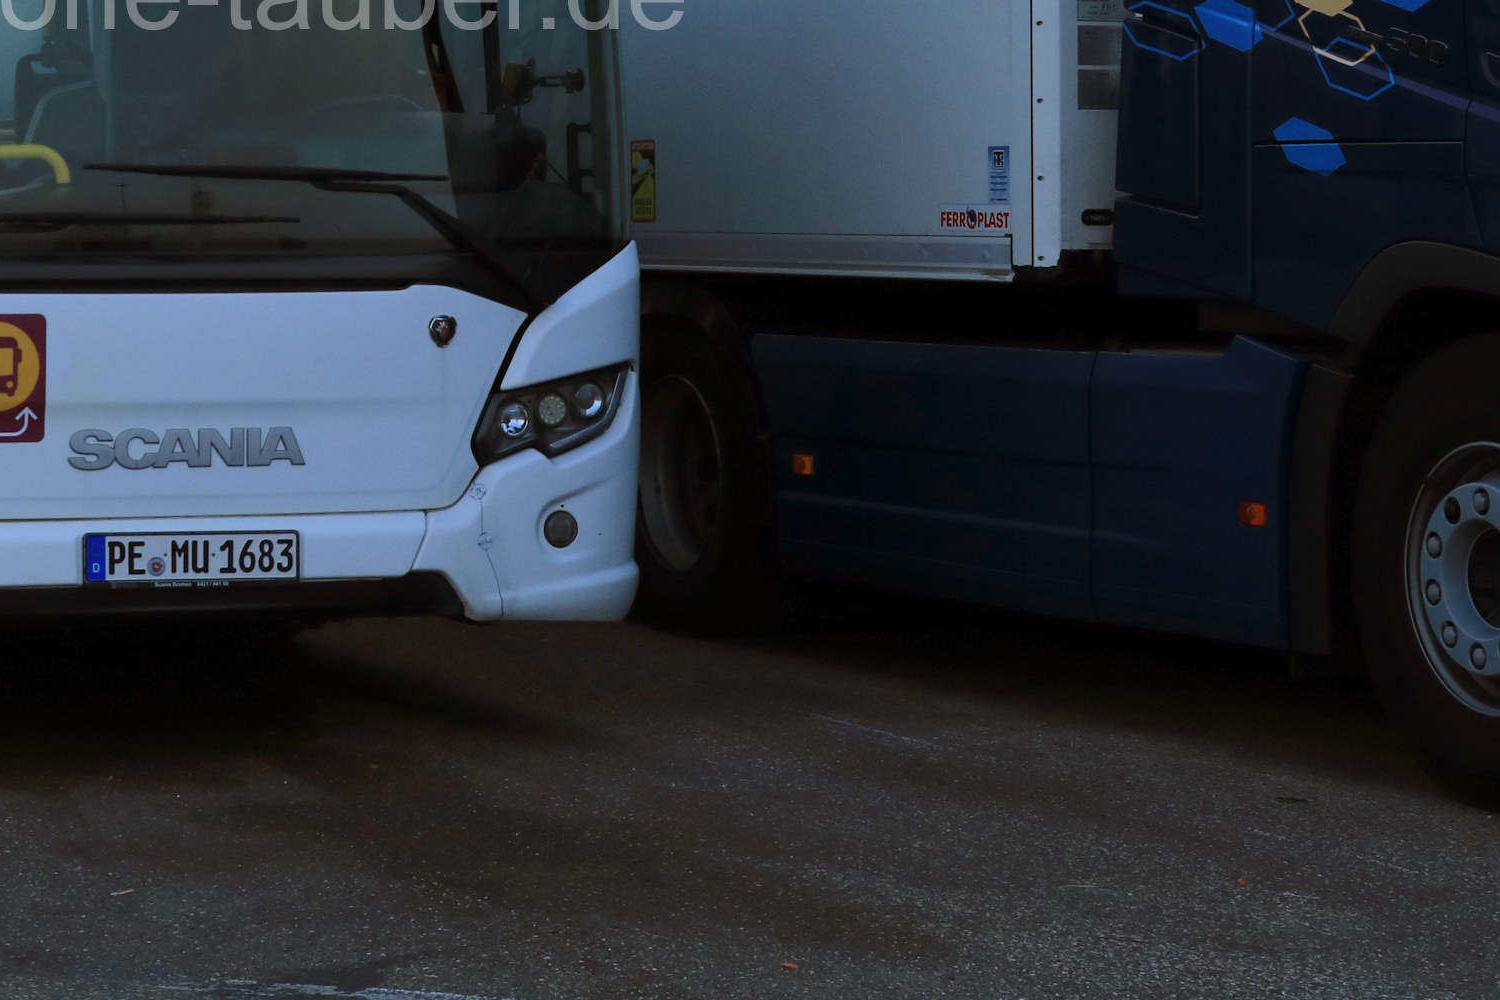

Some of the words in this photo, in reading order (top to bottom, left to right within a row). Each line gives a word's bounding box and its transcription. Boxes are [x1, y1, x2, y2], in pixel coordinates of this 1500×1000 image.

[1101, 4, 1118, 12] FRC
[1386, 26, 1449, 65] 500
[940, 209, 1010, 230] FERROPLAST
[67, 426, 306, 471] SCANIA
[91, 562, 100, 574] D
[107, 541, 146, 575] PE
[171, 540, 209, 573] MU
[219, 539, 294, 574] 1683
